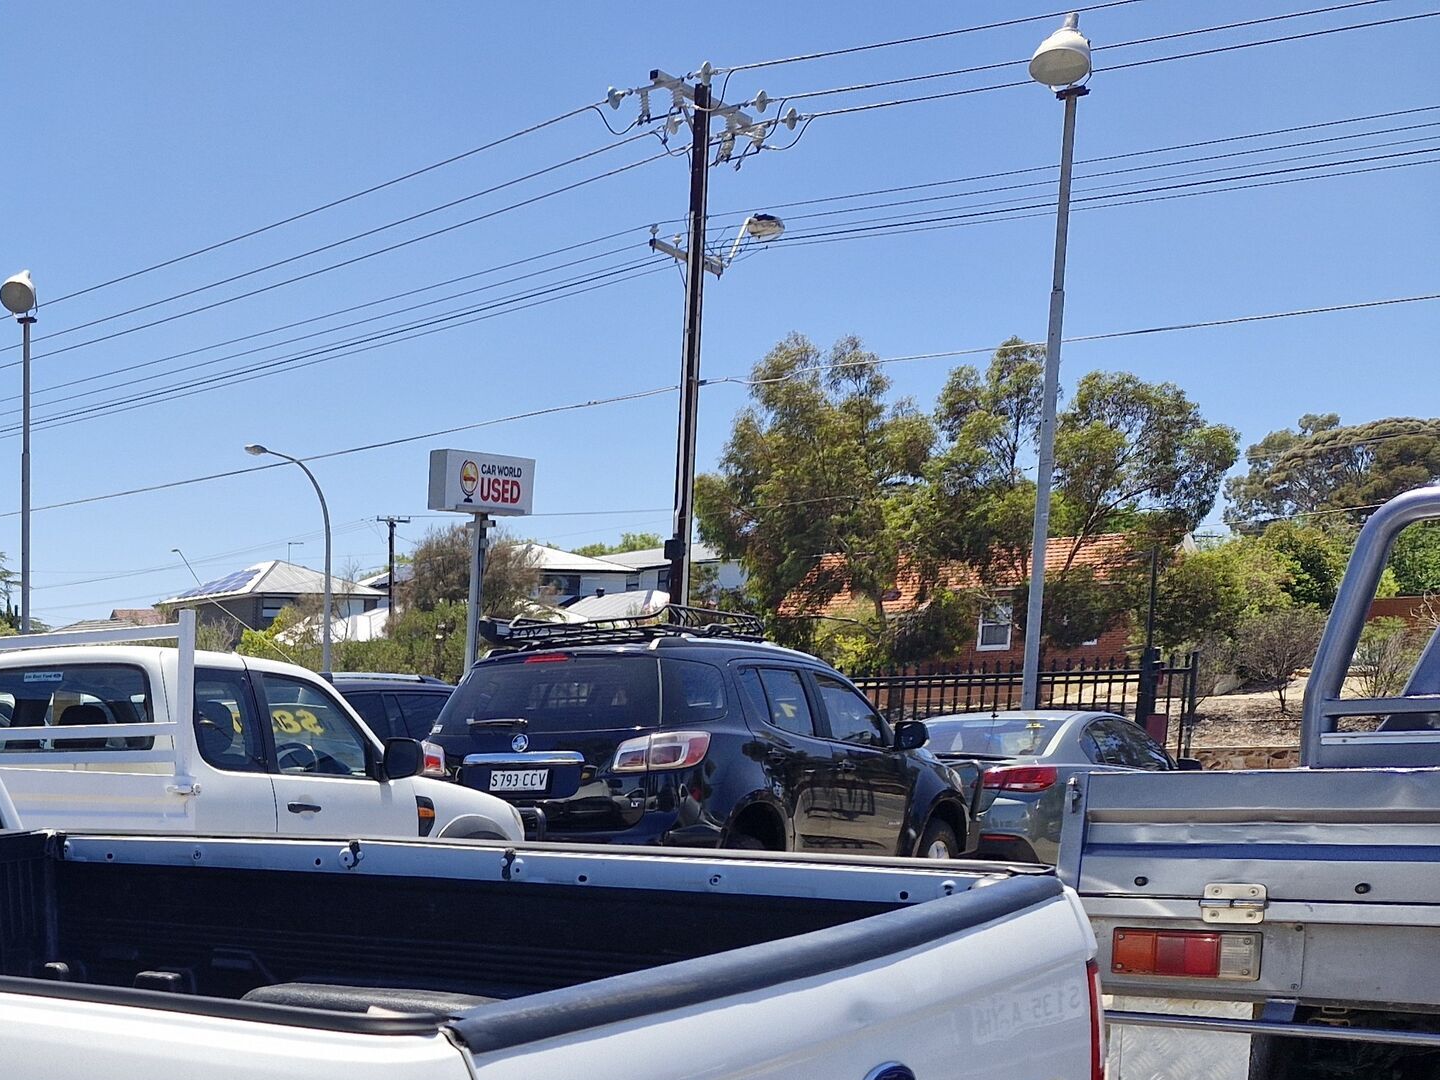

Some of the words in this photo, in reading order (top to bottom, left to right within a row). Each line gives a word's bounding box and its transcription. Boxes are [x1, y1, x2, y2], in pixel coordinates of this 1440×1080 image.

[481, 464, 497, 476] CAR
[498, 465, 522, 478] WORLD
[480, 478, 521, 504] USED
